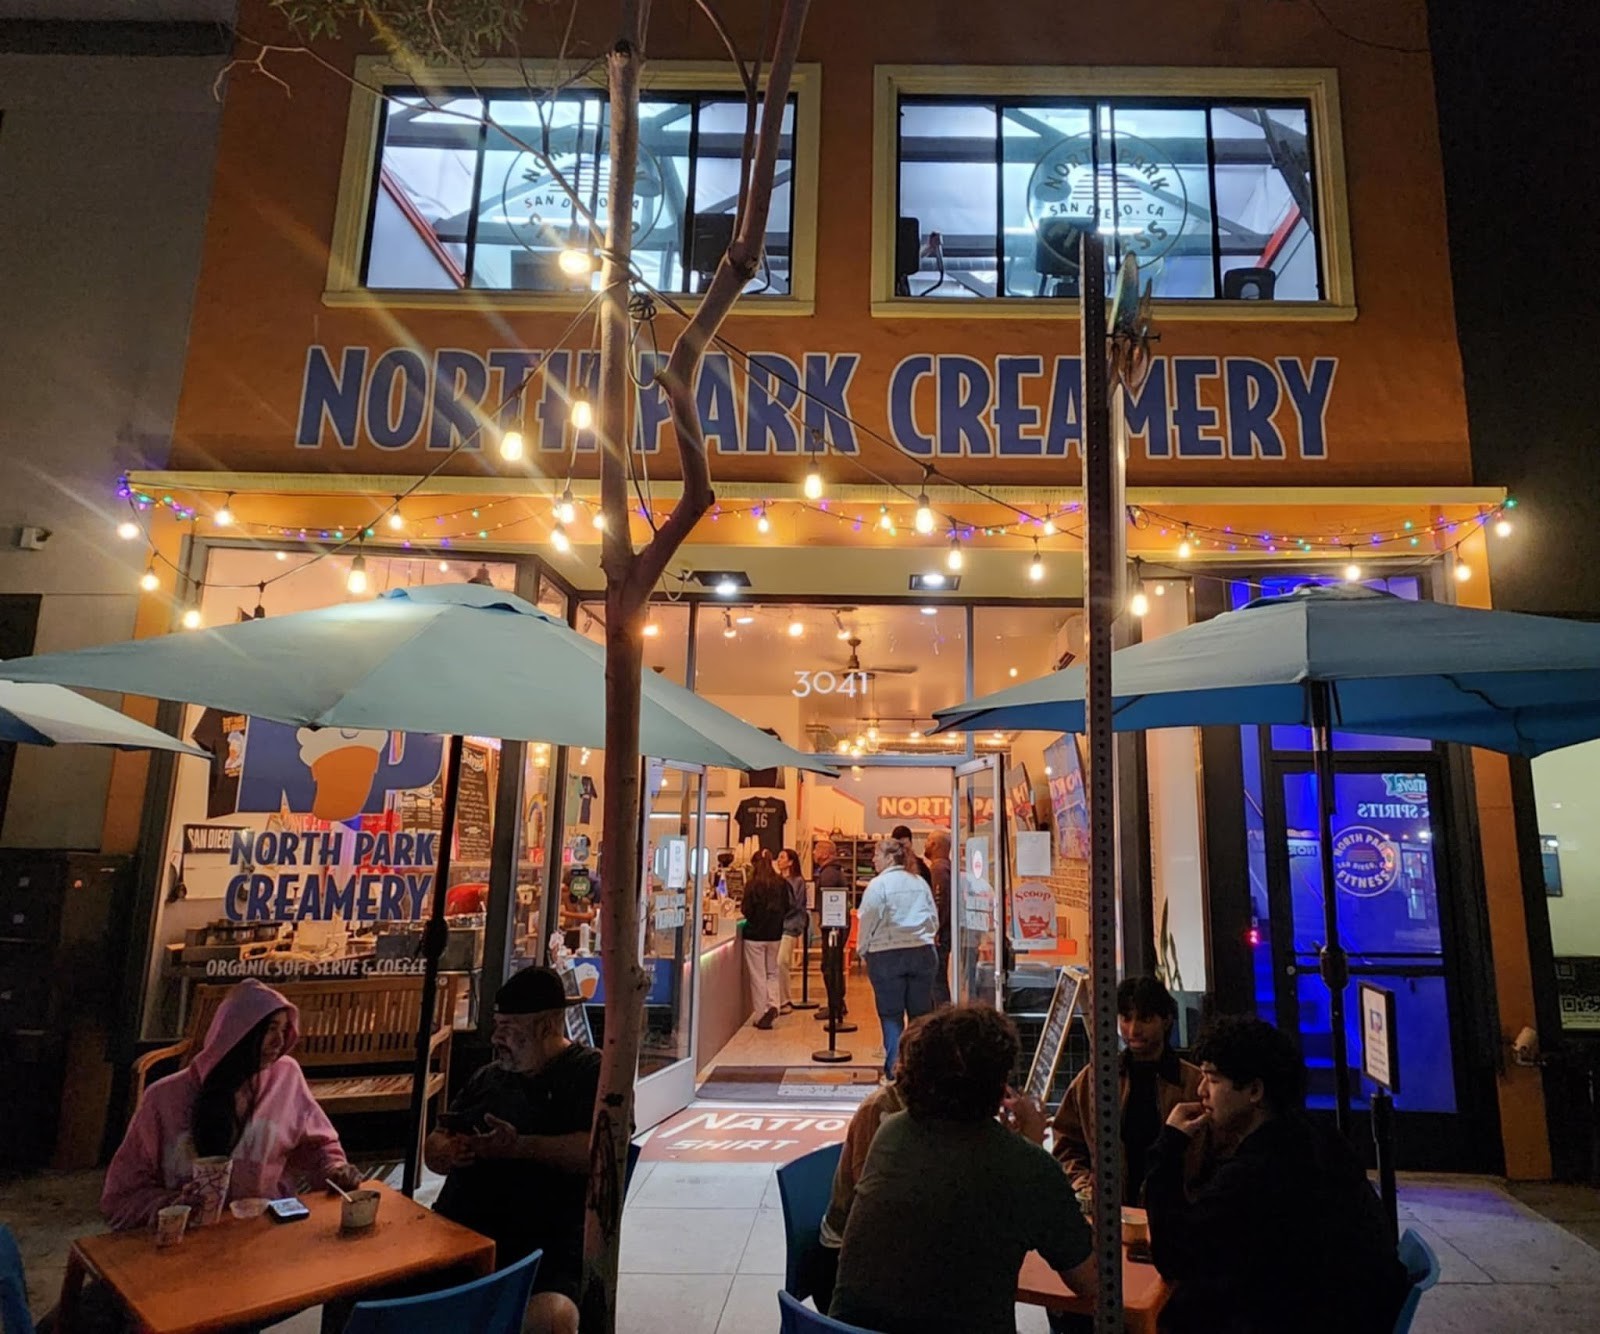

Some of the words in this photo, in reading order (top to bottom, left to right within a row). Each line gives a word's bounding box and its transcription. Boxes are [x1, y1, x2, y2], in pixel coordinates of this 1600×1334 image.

[1118, 148, 1170, 192] PARK
[524, 195, 555, 209] SAN
[1050, 203, 1080, 216] SAN
[1147, 203, 1165, 217] CA
[295, 344, 603, 454] NORTH
[632, 350, 861, 455] PARK
[888, 354, 1340, 460] CREAMERY
[791, 670, 868, 698] 3041
[881, 796, 952, 816] NORTH
[755, 812, 768, 828] 16
[188, 828, 207, 849] SAN
[208, 828, 236, 849] DIEGO
[229, 830, 343, 867] NORTH
[353, 830, 437, 867] PARK
[1336, 870, 1391, 888] FITNESS
[225, 872, 434, 922] CREAMERY
[206, 959, 272, 976] ORGANIC
[275, 959, 311, 976] SOFT
[314, 959, 360, 976] SERVE
[361, 959, 373, 975] &
[376, 958, 428, 976] COFFEE
[664, 1139, 800, 1151] SHIRT
